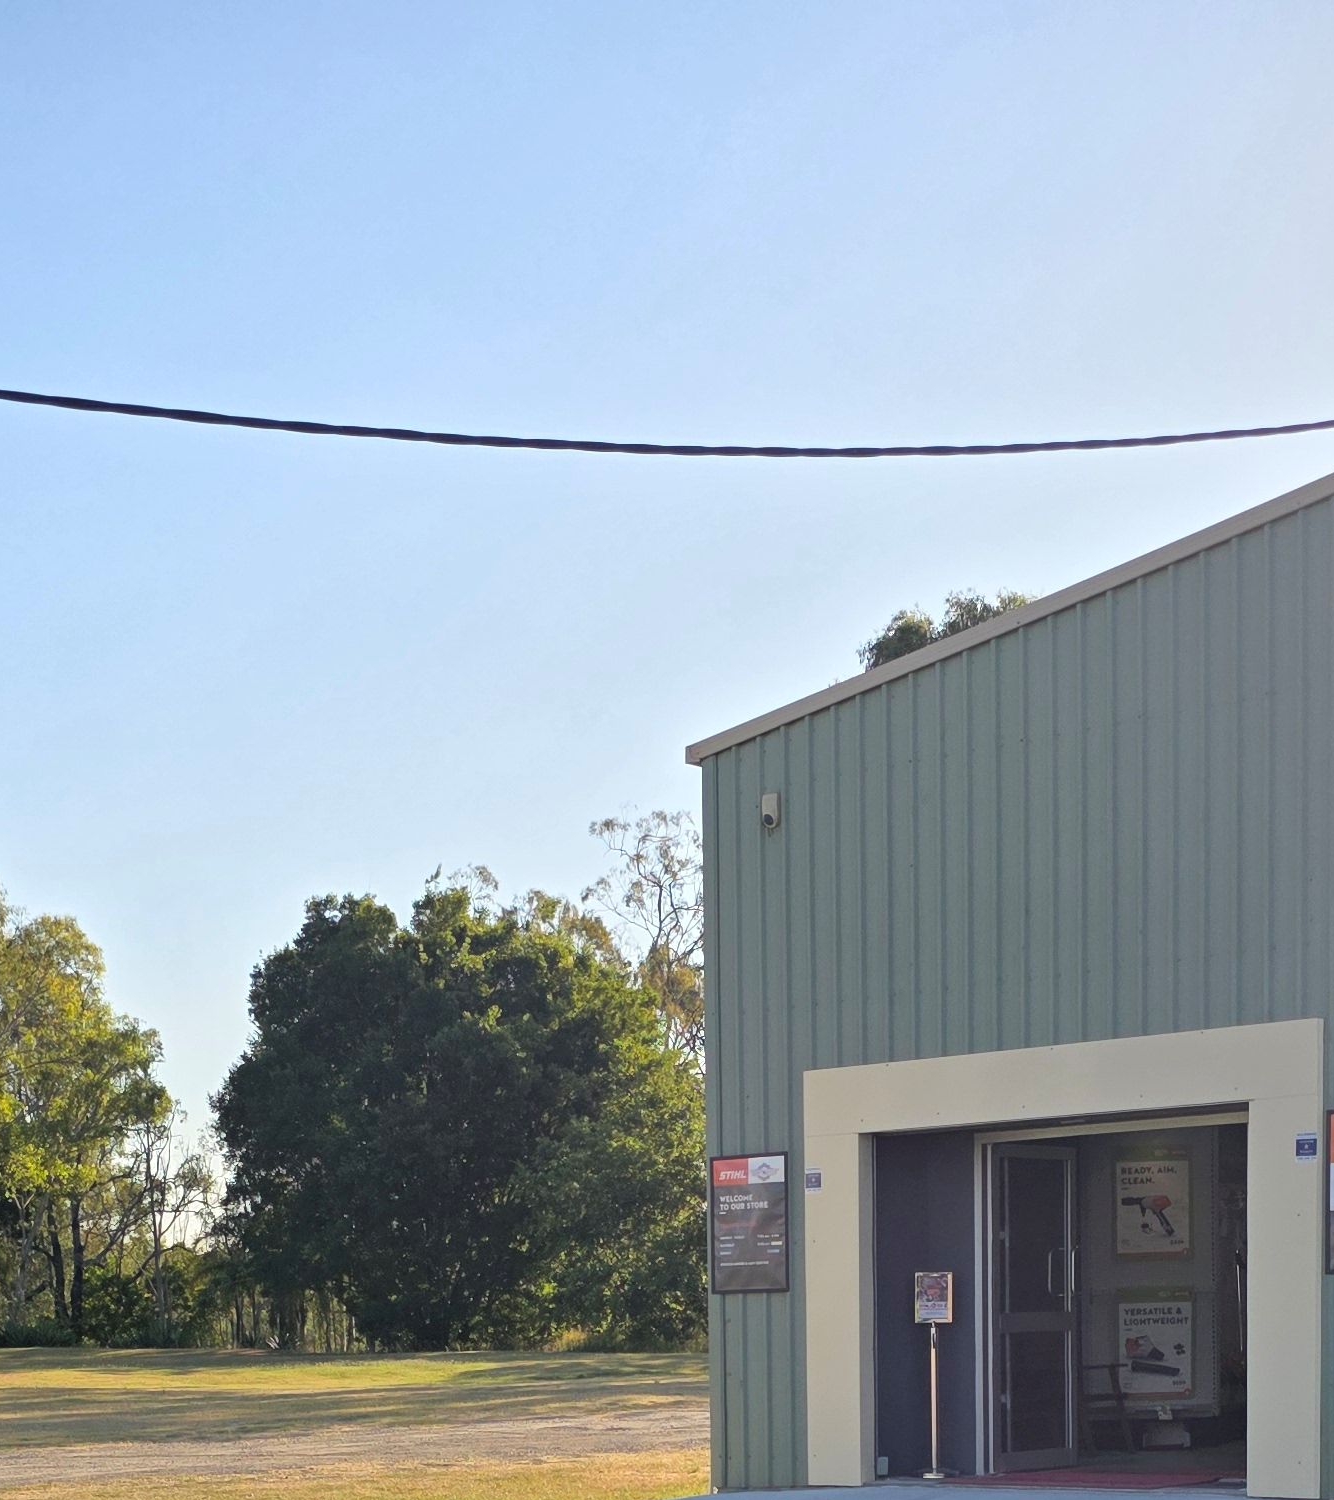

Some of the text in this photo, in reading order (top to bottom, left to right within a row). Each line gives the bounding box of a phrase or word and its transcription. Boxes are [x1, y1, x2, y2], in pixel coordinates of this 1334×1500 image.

[720, 1171, 746, 1181] STIHL
[1123, 1307, 1173, 1316] VERSATILE
[1123, 1317, 1189, 1326] LIGHTWEIGHT
